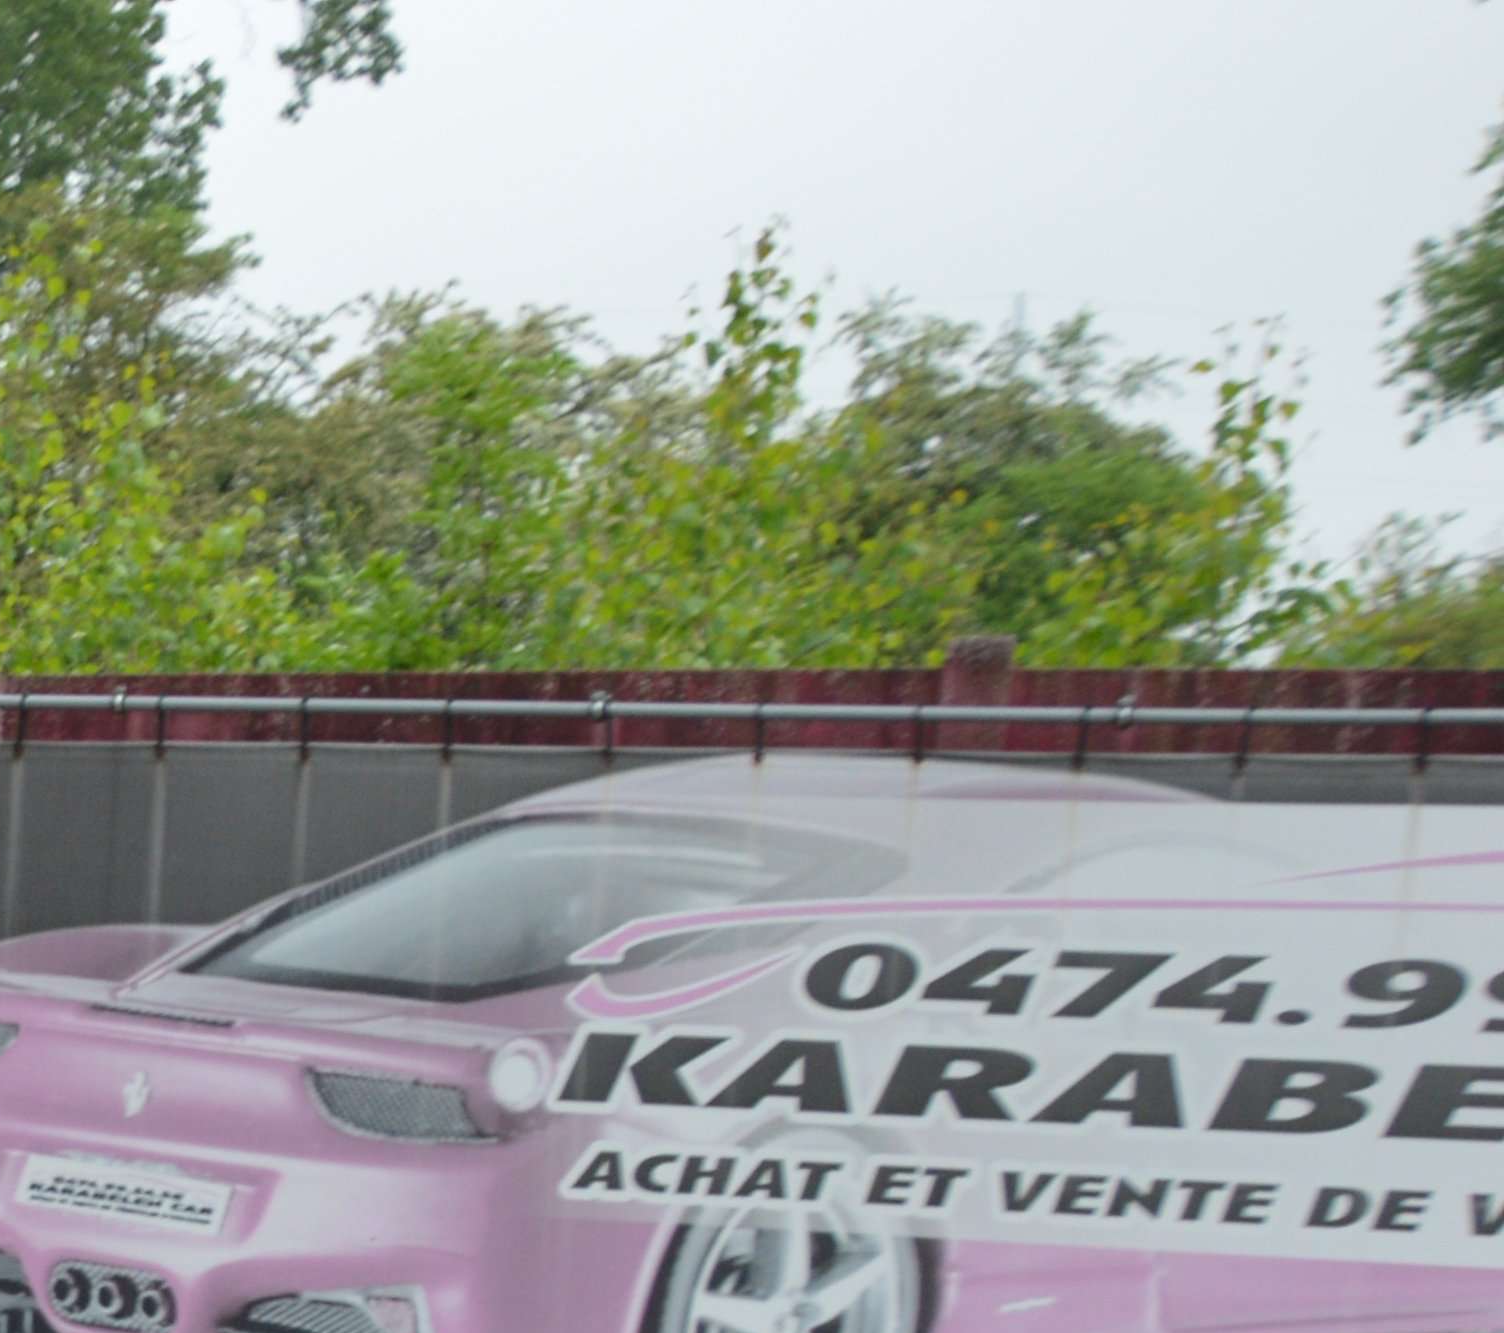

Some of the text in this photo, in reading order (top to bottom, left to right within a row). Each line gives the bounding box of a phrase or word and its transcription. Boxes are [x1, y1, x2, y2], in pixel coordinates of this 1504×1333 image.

[804, 942, 1504, 1033] 0474.9
[571, 1150, 846, 1202] ACHAT
[865, 1165, 971, 1208] ET
[1000, 1170, 1282, 1225] VENTE
[1303, 1186, 1434, 1232] DE
